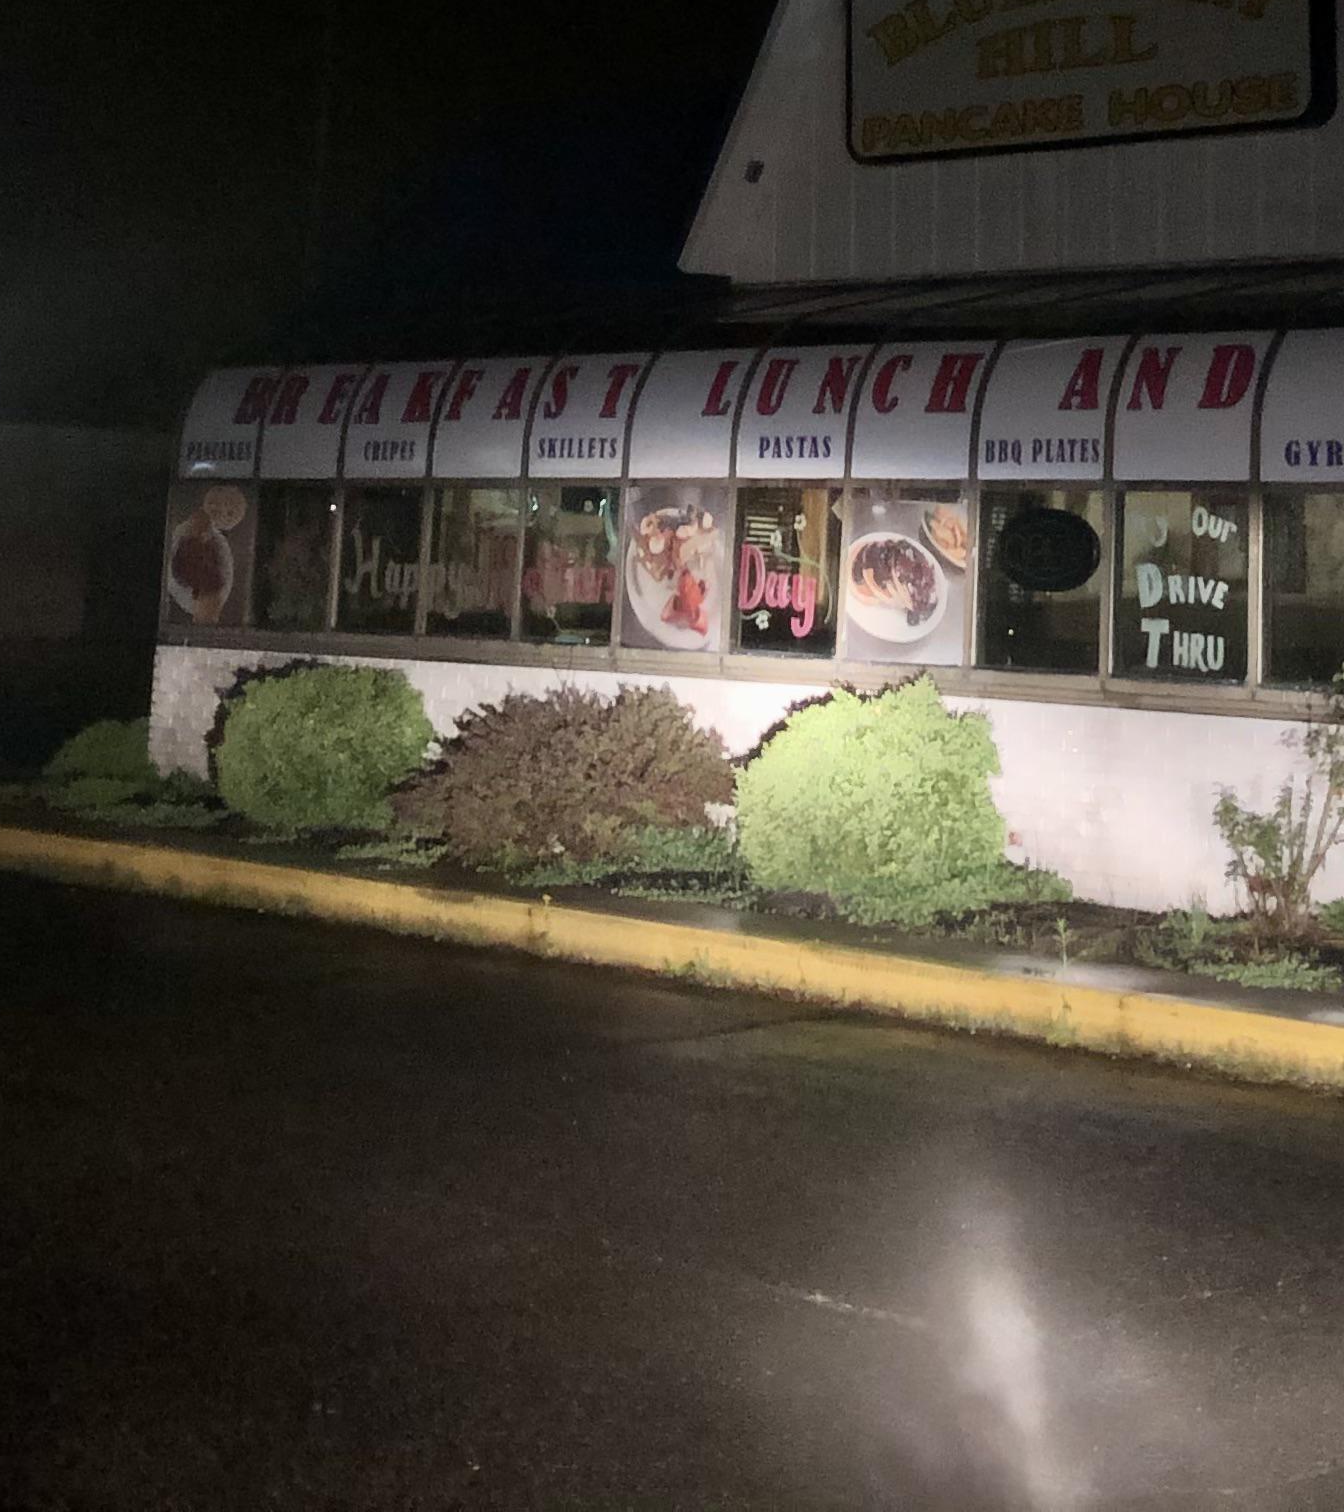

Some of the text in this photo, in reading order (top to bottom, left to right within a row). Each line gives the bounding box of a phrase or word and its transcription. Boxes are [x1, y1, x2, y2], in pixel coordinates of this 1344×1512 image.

[975, 14, 1157, 80] HILL
[862, 71, 1298, 152] PANCAKE HOUSE
[233, 363, 640, 426] BREAKFAST
[701, 353, 985, 417] LUNCH
[1058, 343, 1257, 411] AND
[364, 439, 417, 462] CREPES
[537, 437, 618, 460] SKILLETS
[759, 435, 832, 460] PASTAS
[985, 438, 1101, 464] BBQ PLATES
[737, 542, 817, 638] Day
